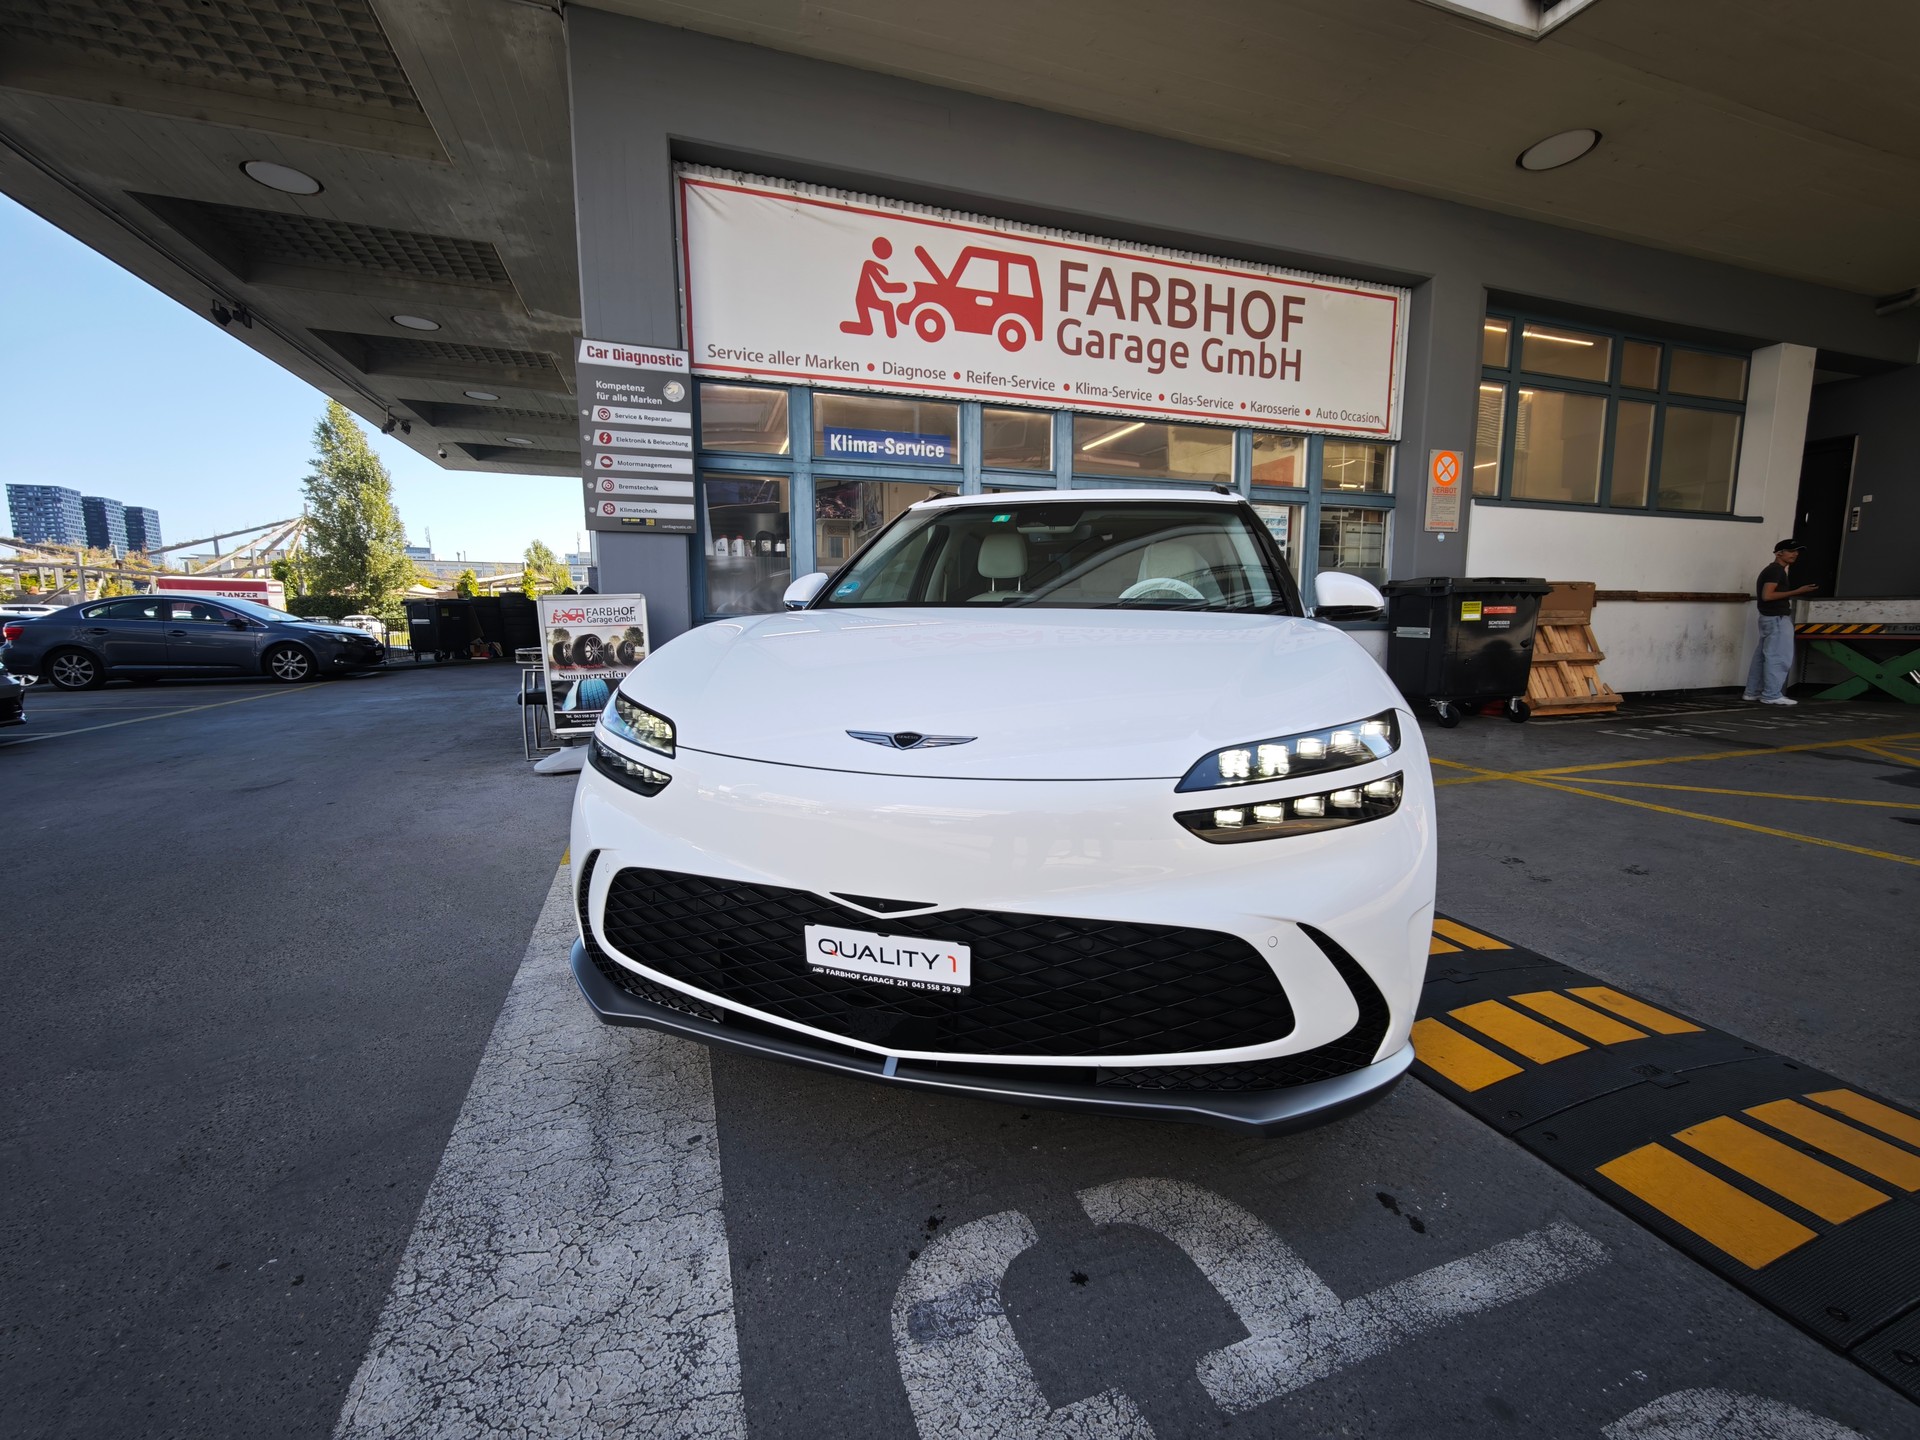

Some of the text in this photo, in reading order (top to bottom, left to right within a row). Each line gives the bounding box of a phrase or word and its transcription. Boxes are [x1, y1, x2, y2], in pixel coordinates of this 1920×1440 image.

[1059, 260, 1306, 343] FARBHOF
[1057, 318, 1302, 382] Garage GmbH
[586, 345, 683, 368] Car Diagnostic
[595, 380, 645, 393] Kompetenz
[707, 343, 1380, 425] Service aller Marken Diagnose Reifen-Service Klima-Service Glas-Service Karosserie Auto Occasion
[596, 391, 663, 405] für alle Marken
[615, 412, 637, 421] Service
[644, 414, 673, 424] Reparatur
[616, 436, 646, 445] Elektronik
[653, 438, 689, 448] Beleuchtung
[829, 434, 945, 460] Klima-Service
[617, 459, 673, 470] Motormanagement
[618, 483, 659, 491] Bremstechnik
[1432, 486, 1457, 495] VERBOT
[619, 506, 658, 515] Klimatechnik
[586, 607, 635, 616] FARBHOF
[614, 615, 637, 623] GmbH
[559, 670, 627, 680] Sommerreifen
[818, 938, 958, 973] QUALITY 1
[826, 968, 861, 980] FARBHOF
[863, 974, 894, 986] GARAGE
[897, 979, 908, 987] ZH
[911, 981, 925, 989] 043
[942, 985, 951, 993] 29
[952, 986, 962, 994] 29
